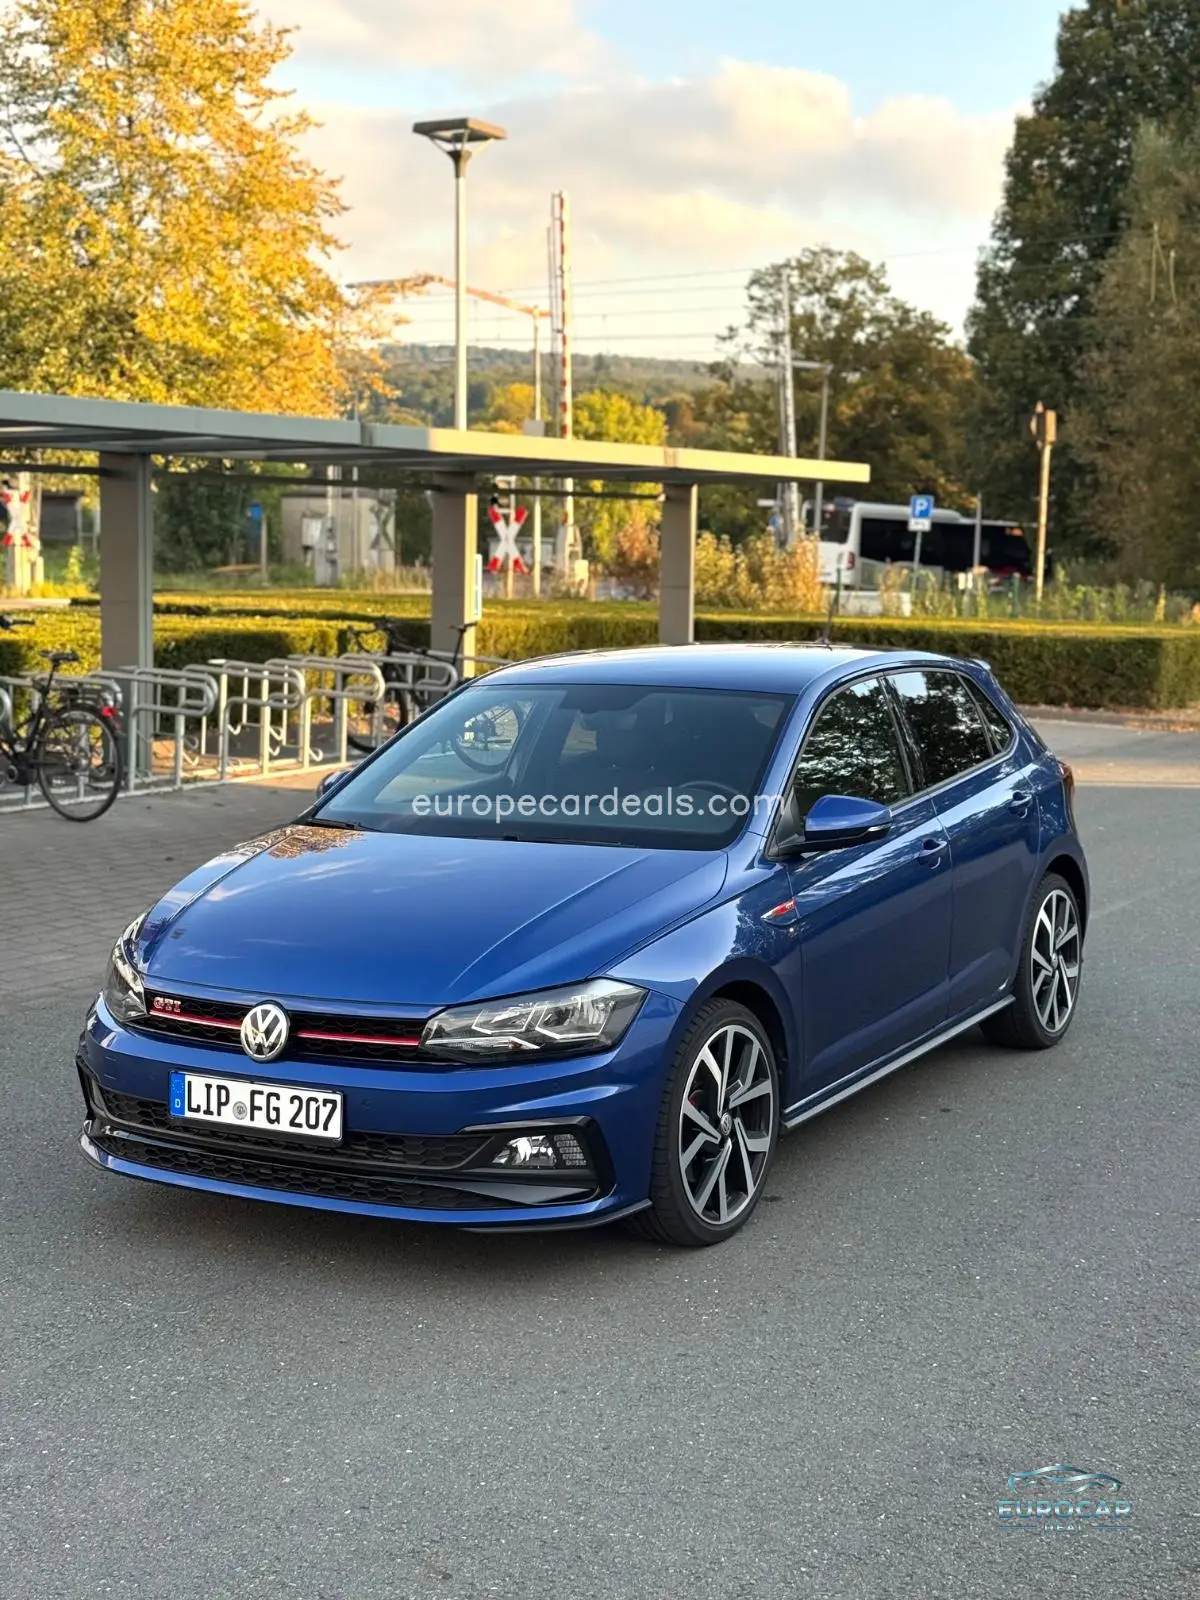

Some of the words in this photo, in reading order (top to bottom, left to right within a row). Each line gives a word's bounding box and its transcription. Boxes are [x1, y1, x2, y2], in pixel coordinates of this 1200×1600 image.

[915, 500, 929, 517] P
[153, 996, 181, 1013] GTI
[174, 1098, 181, 1108] D
[187, 1080, 230, 1116] LIP
[250, 1089, 281, 1124] FG
[289, 1095, 338, 1131] 207
